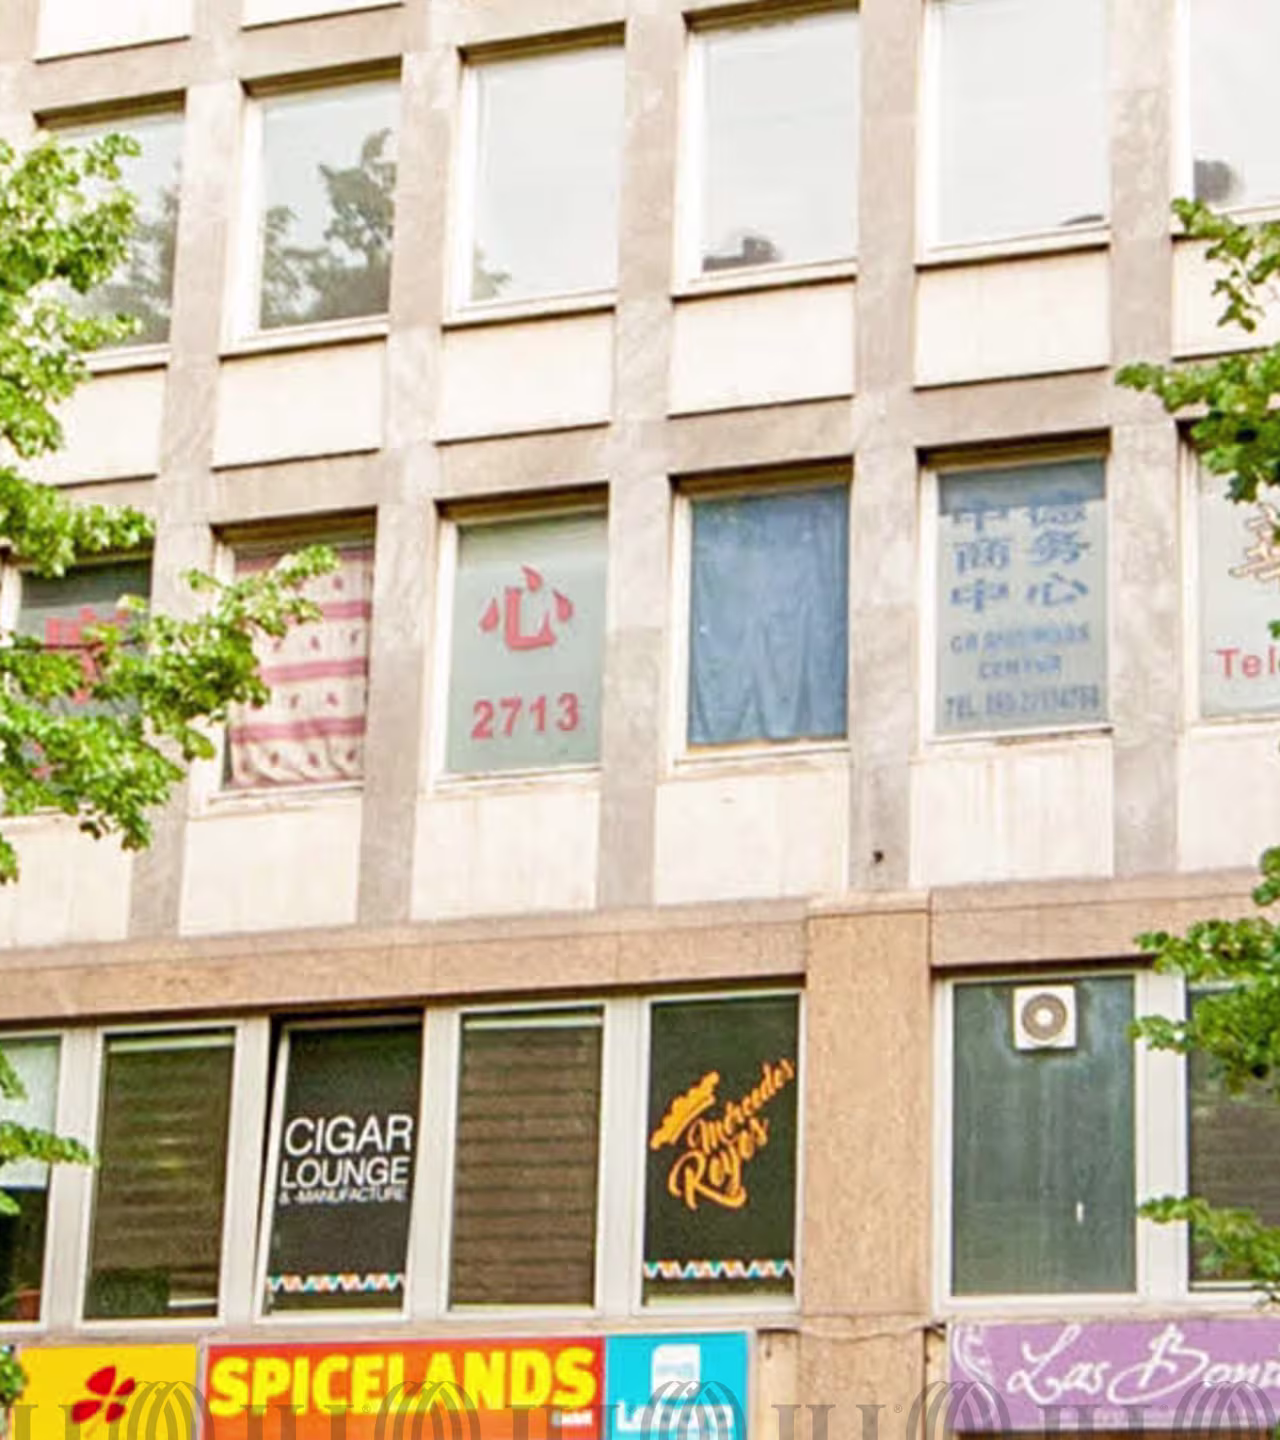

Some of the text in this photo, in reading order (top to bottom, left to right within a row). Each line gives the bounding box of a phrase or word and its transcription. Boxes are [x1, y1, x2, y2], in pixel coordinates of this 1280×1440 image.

[478, 565, 573, 652] 心
[950, 571, 1090, 611] 中心
[472, 693, 581, 741] 2713
[285, 1113, 414, 1157] CIGAR
[281, 1156, 410, 1190] LOUNGE
[209, 1346, 597, 1417] SPICELANDS
[1007, 1324, 1112, 1405] Las
